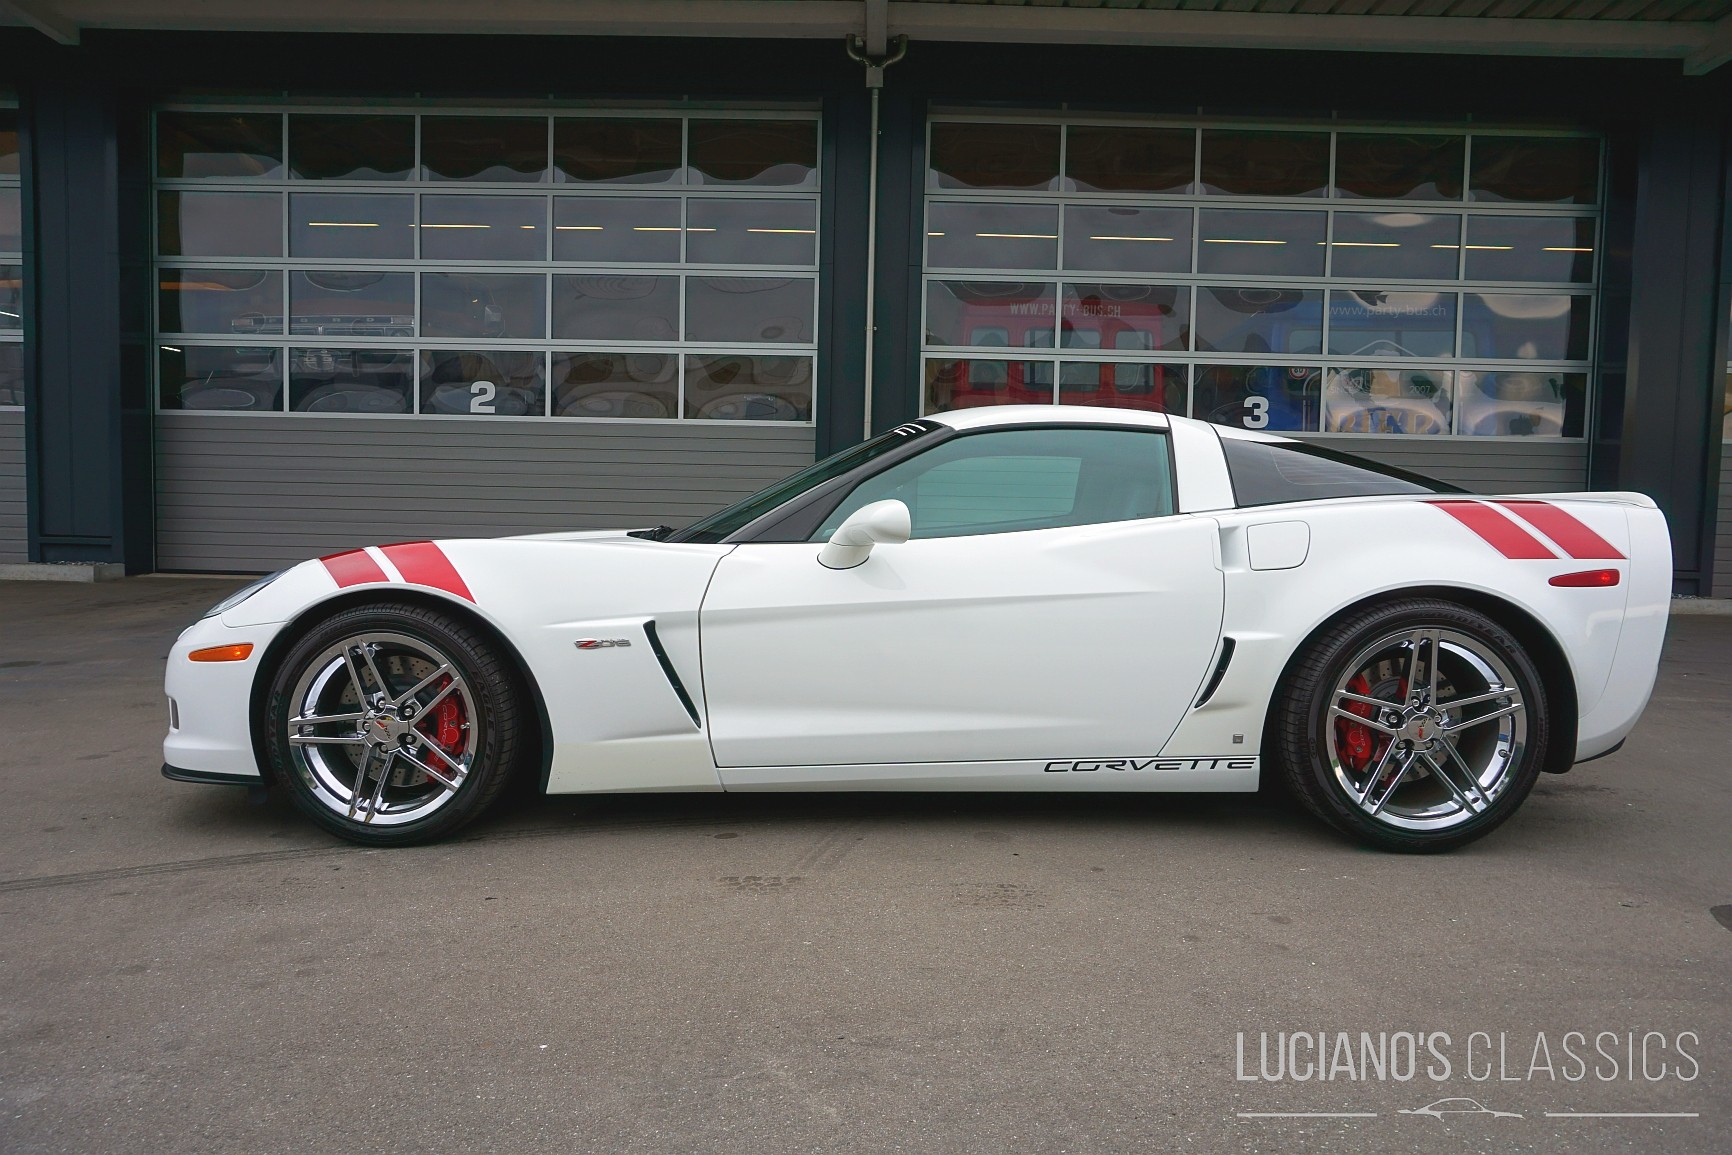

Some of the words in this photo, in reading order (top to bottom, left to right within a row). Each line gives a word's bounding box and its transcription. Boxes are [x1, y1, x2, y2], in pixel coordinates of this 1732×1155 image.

[1010, 303, 1121, 318] WWW.PATY-BUS.CH
[1409, 385, 1431, 394] 2007
[470, 381, 496, 414] 2
[1242, 395, 1269, 429] 3
[574, 637, 632, 650] Z06
[1044, 757, 1257, 773] CORVETTE
